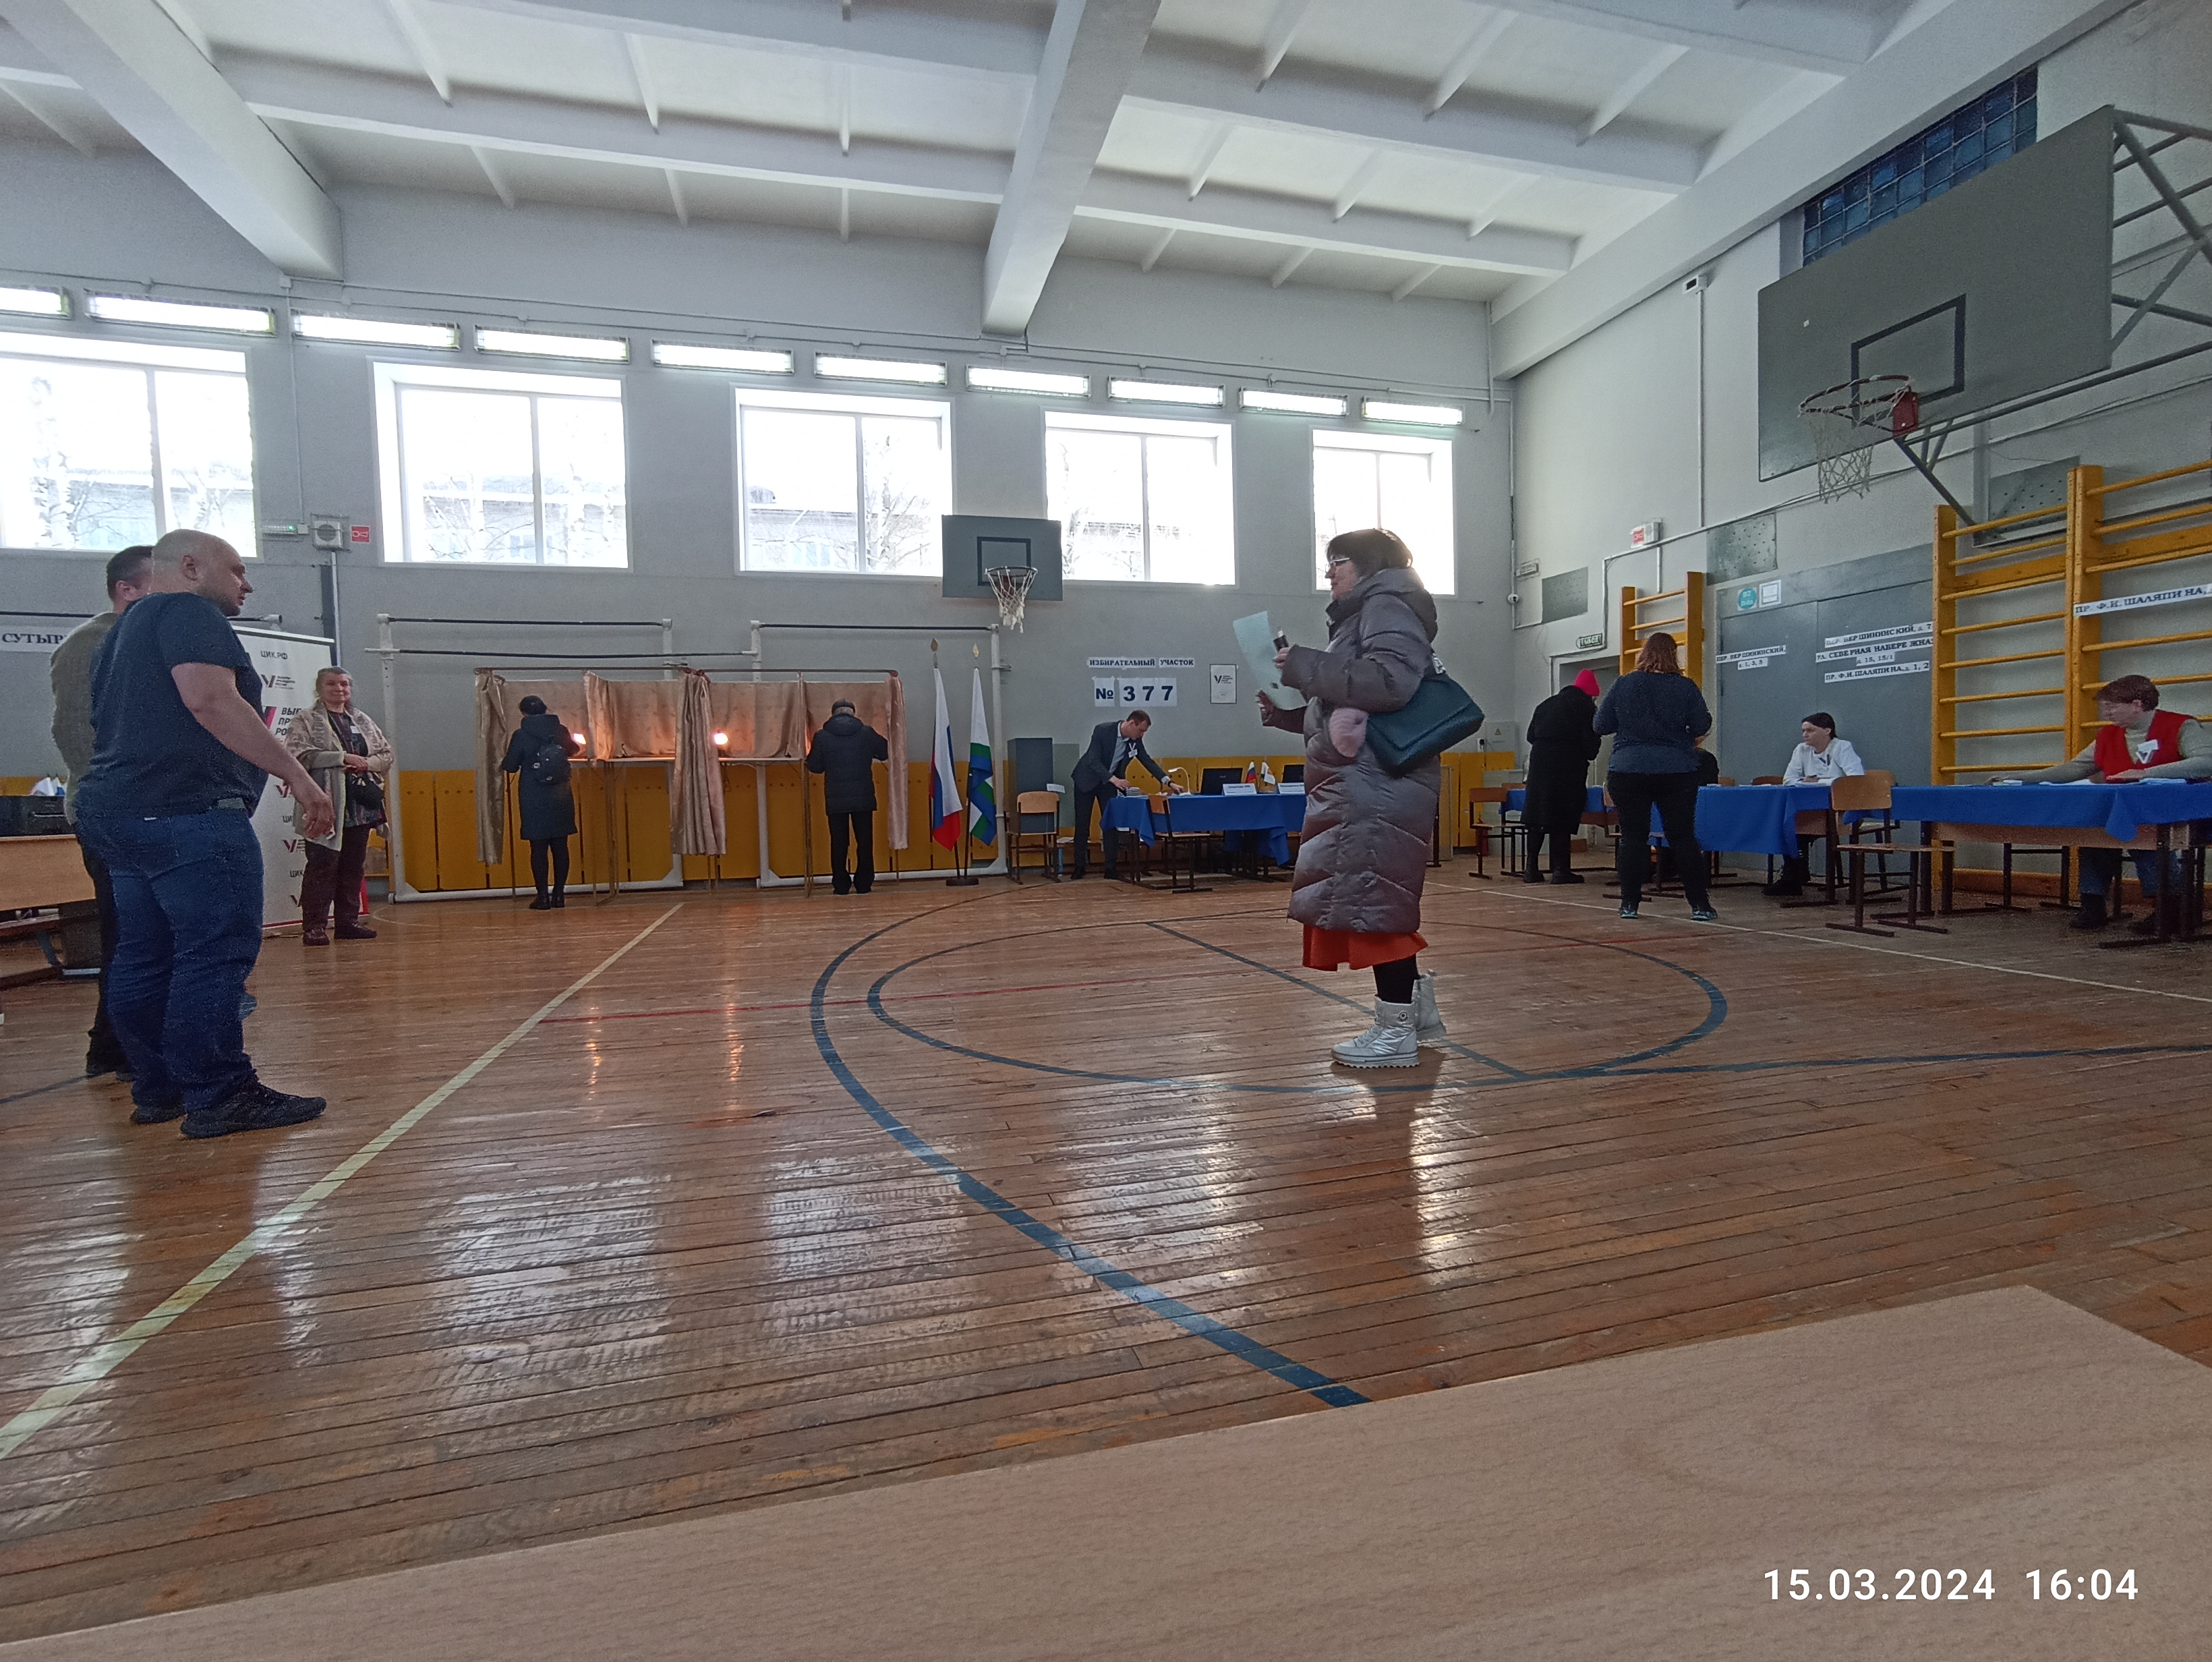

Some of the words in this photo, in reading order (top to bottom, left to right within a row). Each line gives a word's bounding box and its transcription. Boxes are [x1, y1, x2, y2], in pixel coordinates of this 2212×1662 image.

[2075, 605, 2092, 613] ПР.
[2, 633, 67, 644] СУТЫР
[260, 650, 288, 660] ЦИК.РФ
[1089, 658, 1155, 666] ИЗБИРАТЕЛЬНЫЙ
[1096, 688, 1114, 699] №
[1123, 685, 1173, 701] 377
